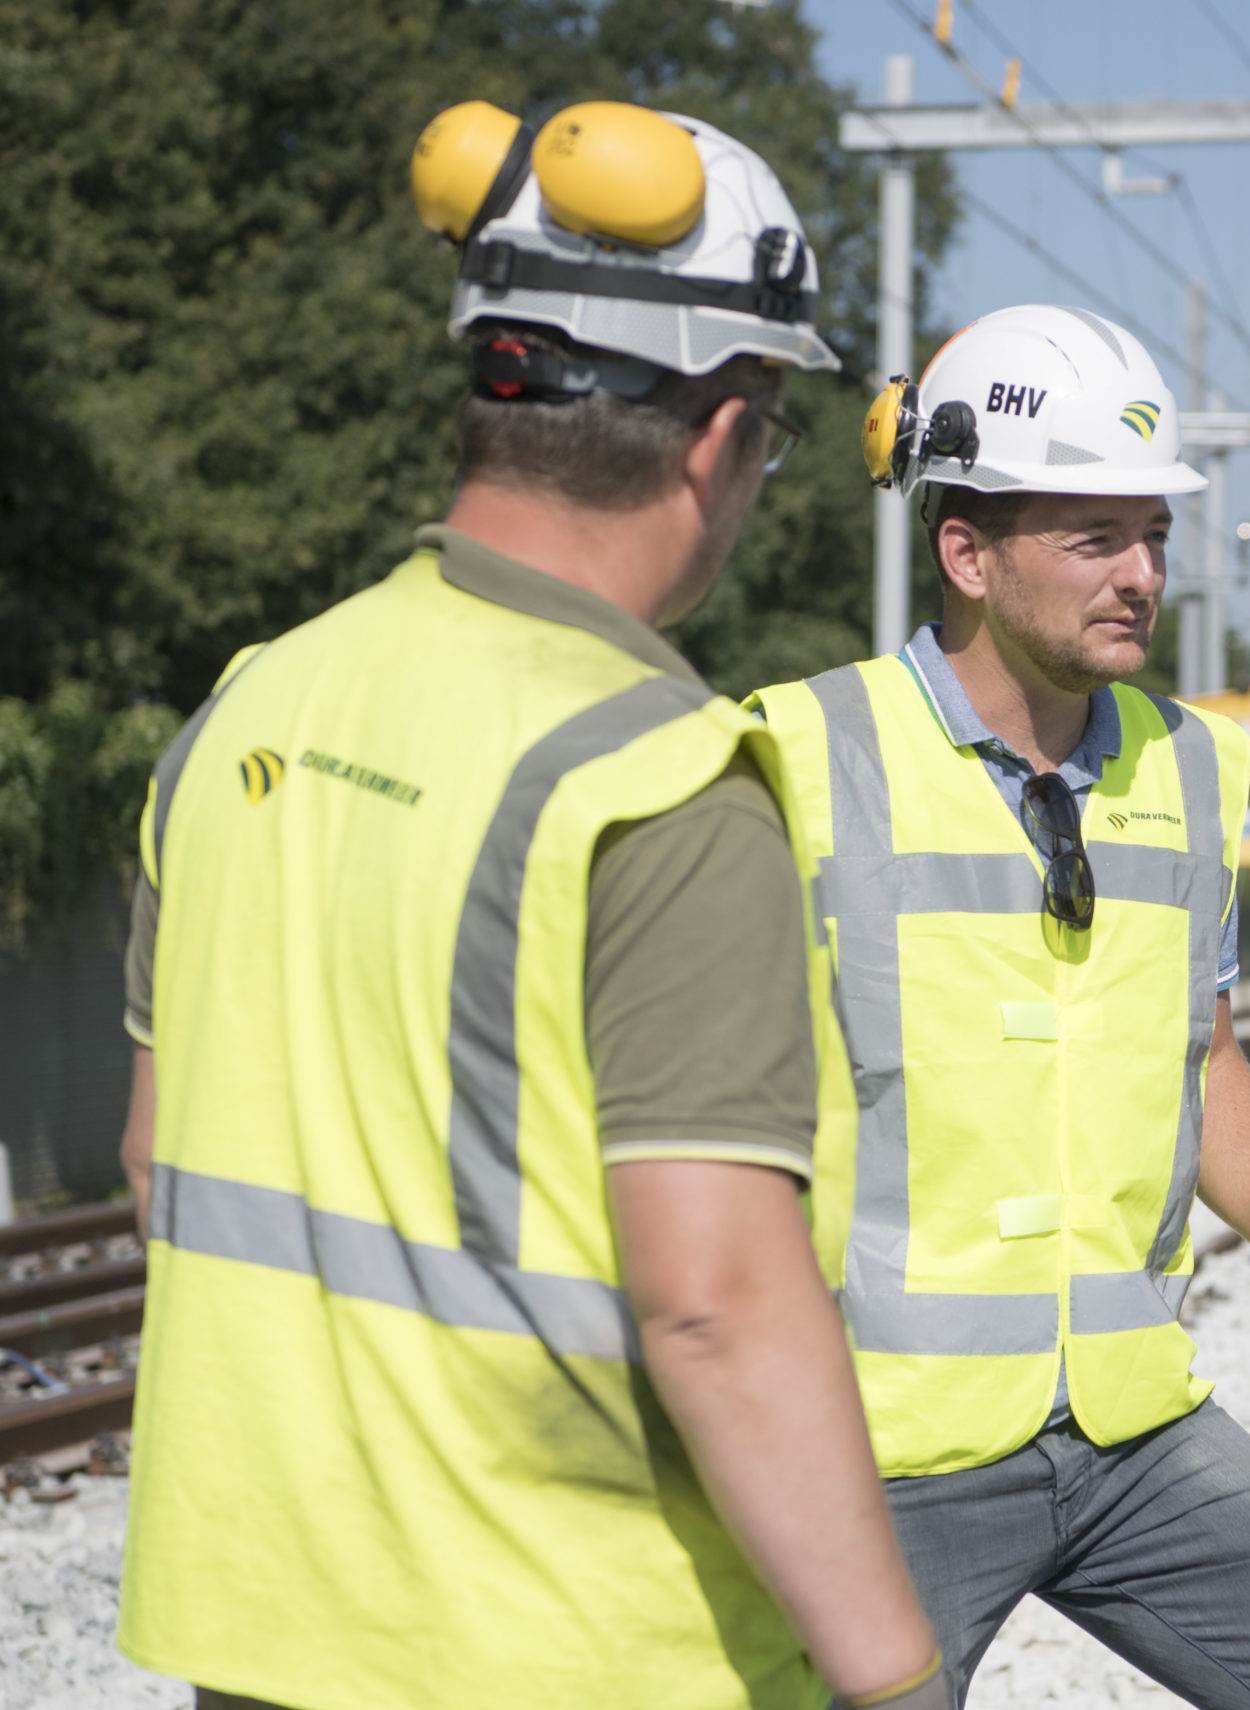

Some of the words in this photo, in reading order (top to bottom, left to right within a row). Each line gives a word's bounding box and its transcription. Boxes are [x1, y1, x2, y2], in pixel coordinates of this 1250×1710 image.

[986, 382, 1047, 419] BHV
[1130, 811, 1151, 820] DURA
[1152, 812, 1182, 825] VERMEER
